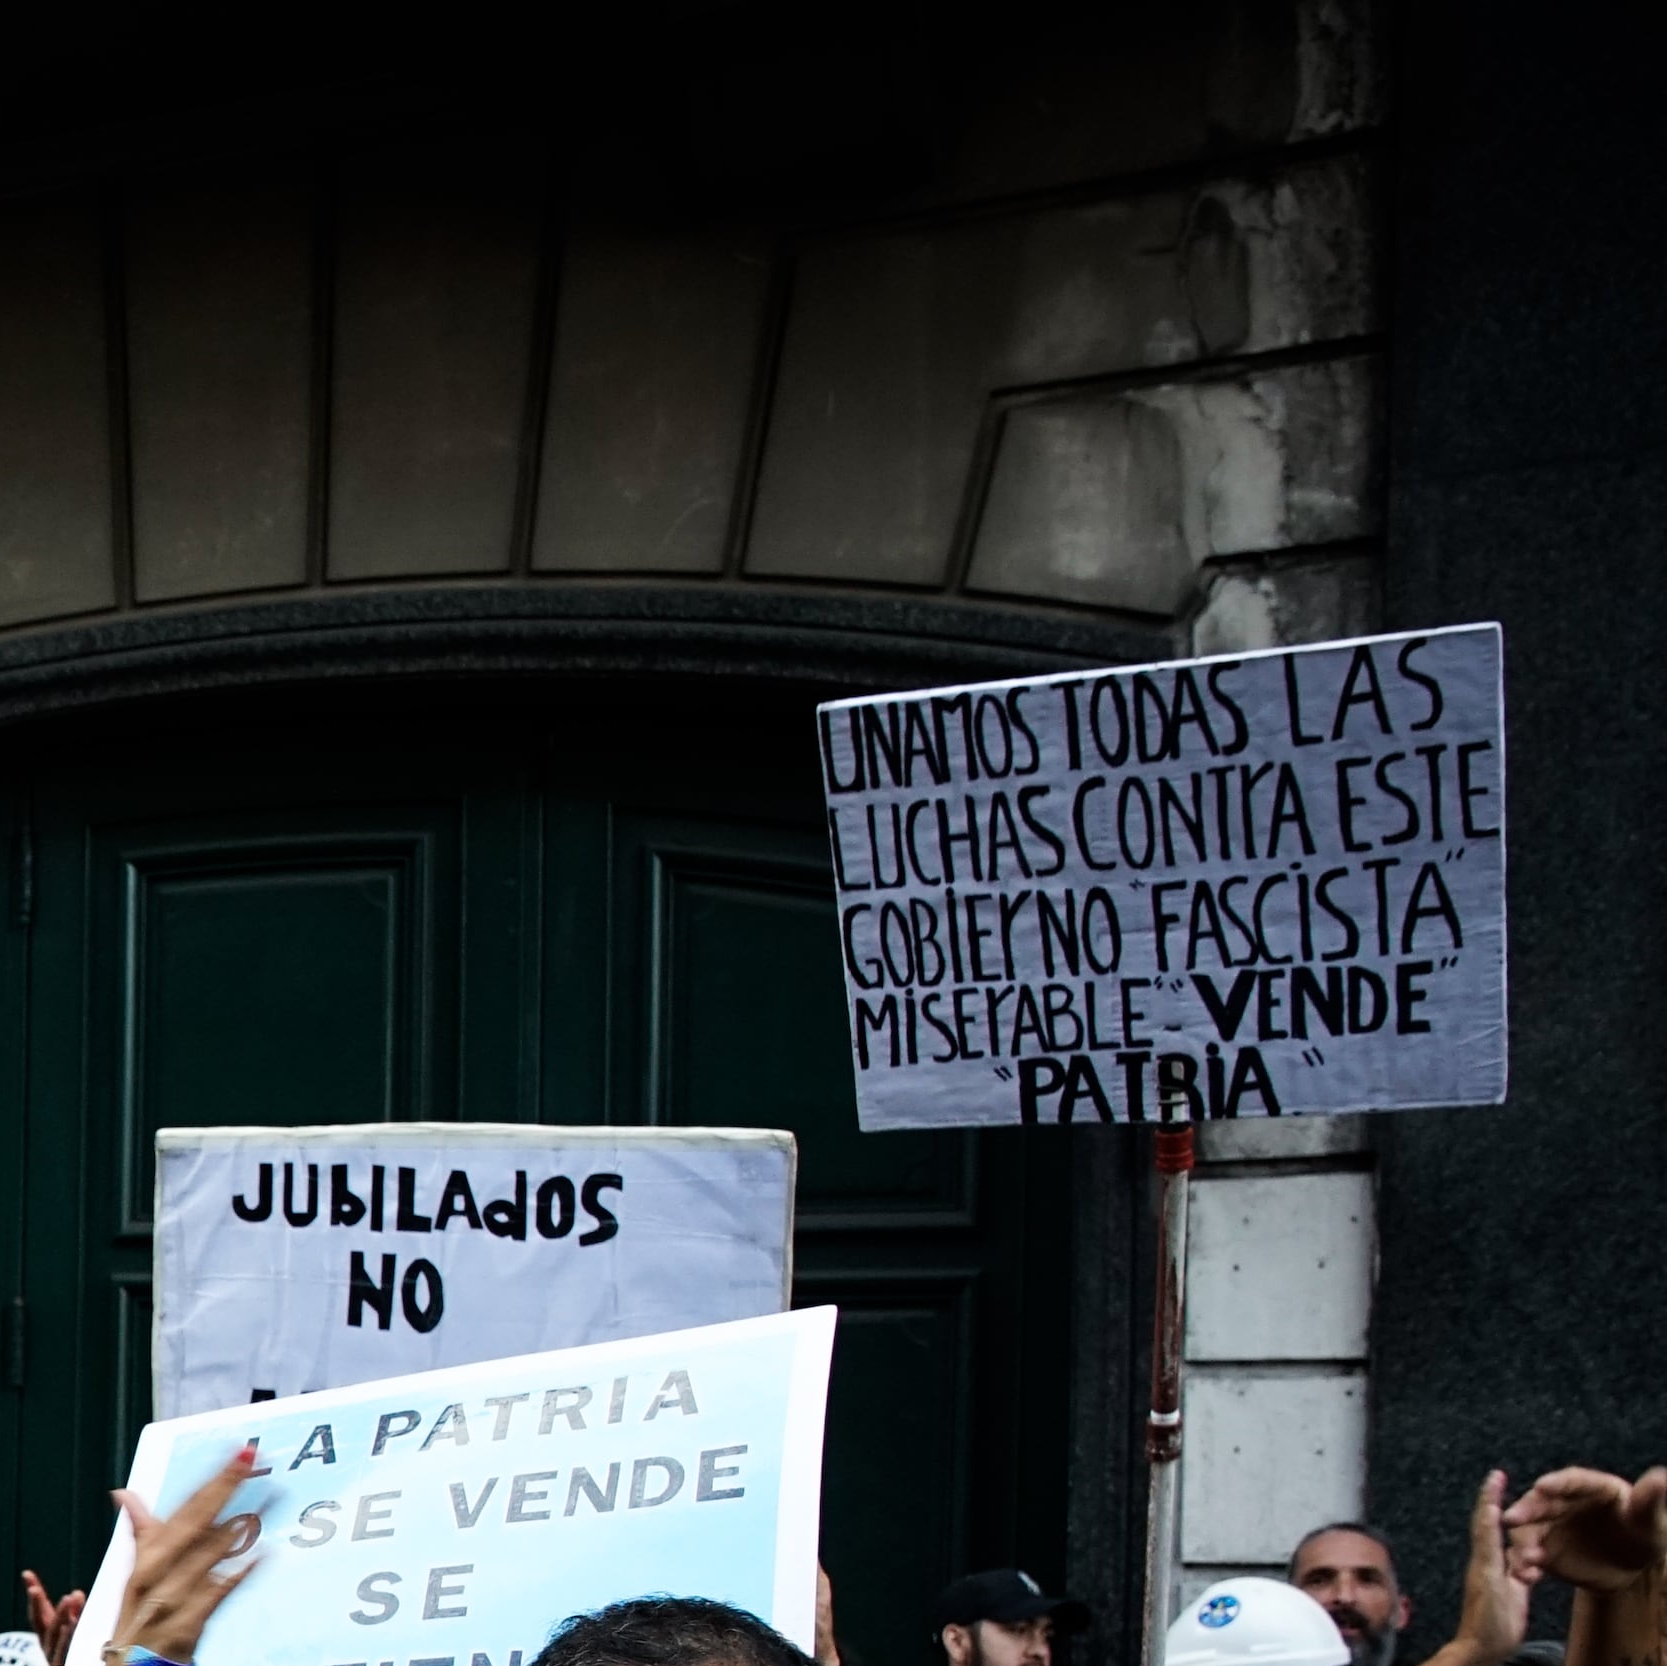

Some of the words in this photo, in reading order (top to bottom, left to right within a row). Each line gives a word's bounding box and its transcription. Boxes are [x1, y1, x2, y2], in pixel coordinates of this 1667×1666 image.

[820, 684, 1042, 794] UNAMOS
[1050, 658, 1249, 771] TODAS
[1282, 638, 1445, 747] LAS
[828, 785, 1065, 891] LUCHAS
[1337, 740, 1501, 853] ESTE
[346, 1250, 446, 1334] NO
[244, 1423, 338, 1480] LA
[371, 1368, 699, 1457] PATRIA
[288, 1489, 402, 1549] SE
[449, 1444, 750, 1529] VENDE
[349, 1563, 475, 1626] SE
